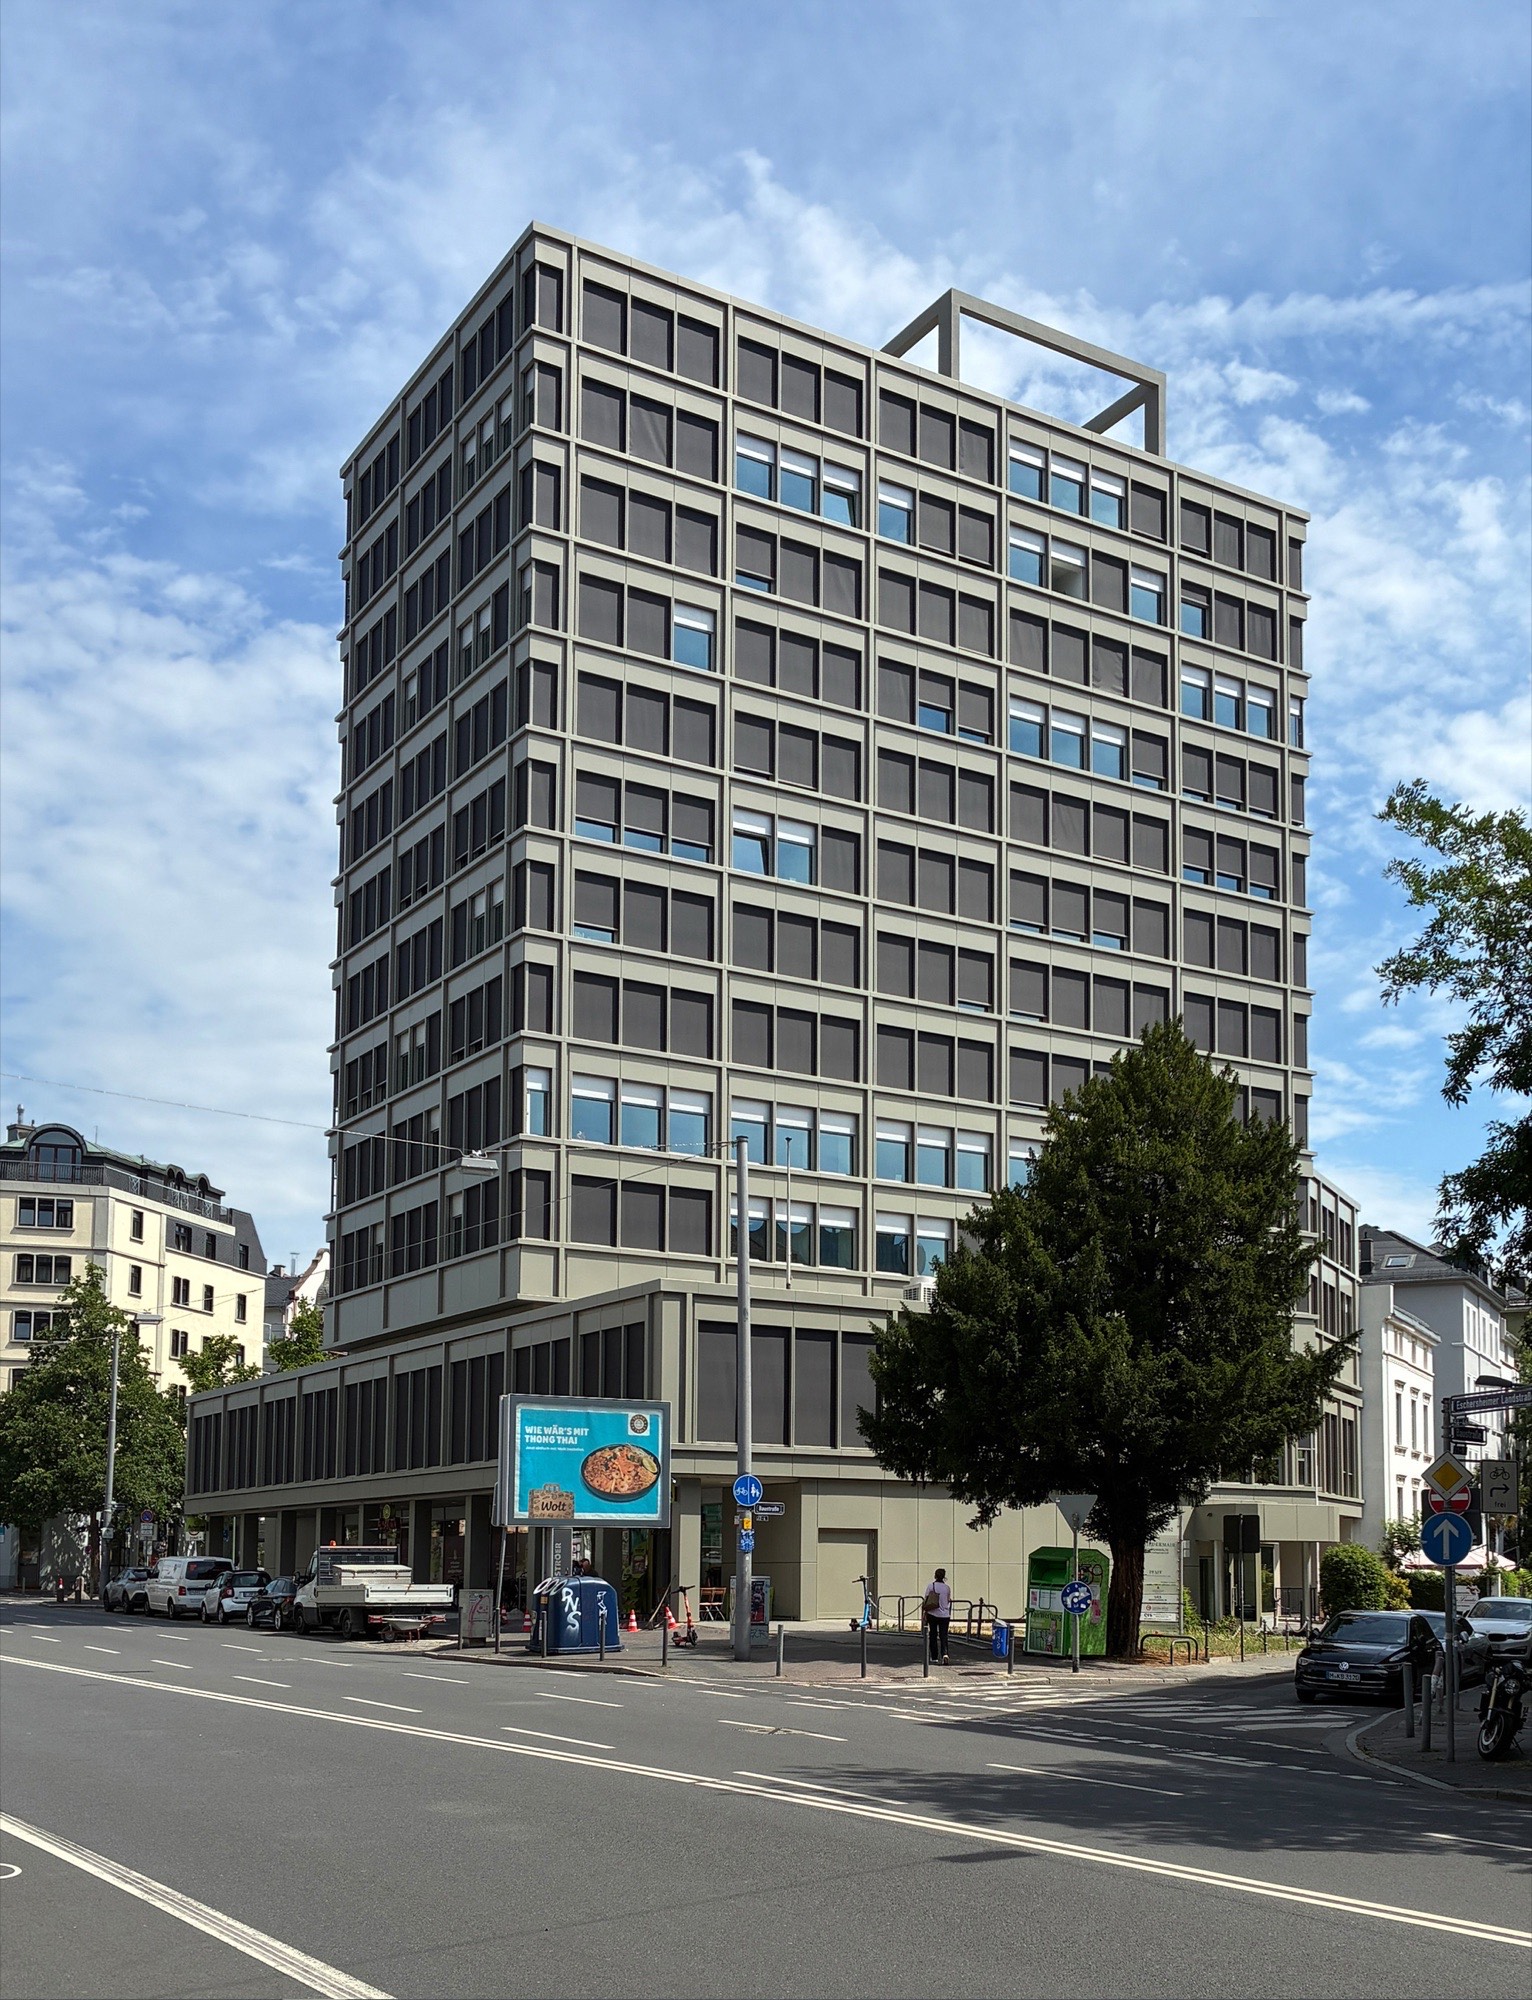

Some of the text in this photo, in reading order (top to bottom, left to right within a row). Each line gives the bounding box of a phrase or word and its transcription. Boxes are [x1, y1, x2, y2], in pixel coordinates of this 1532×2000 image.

[1456, 1392, 1532, 1410] Eschersheimer Landstraß
[524, 1424, 590, 1436] WIE WÄR'S MIT
[524, 1434, 578, 1445] THONG THAI
[541, 1500, 567, 1512] Wolt
[1494, 1500, 1507, 1508] frei
